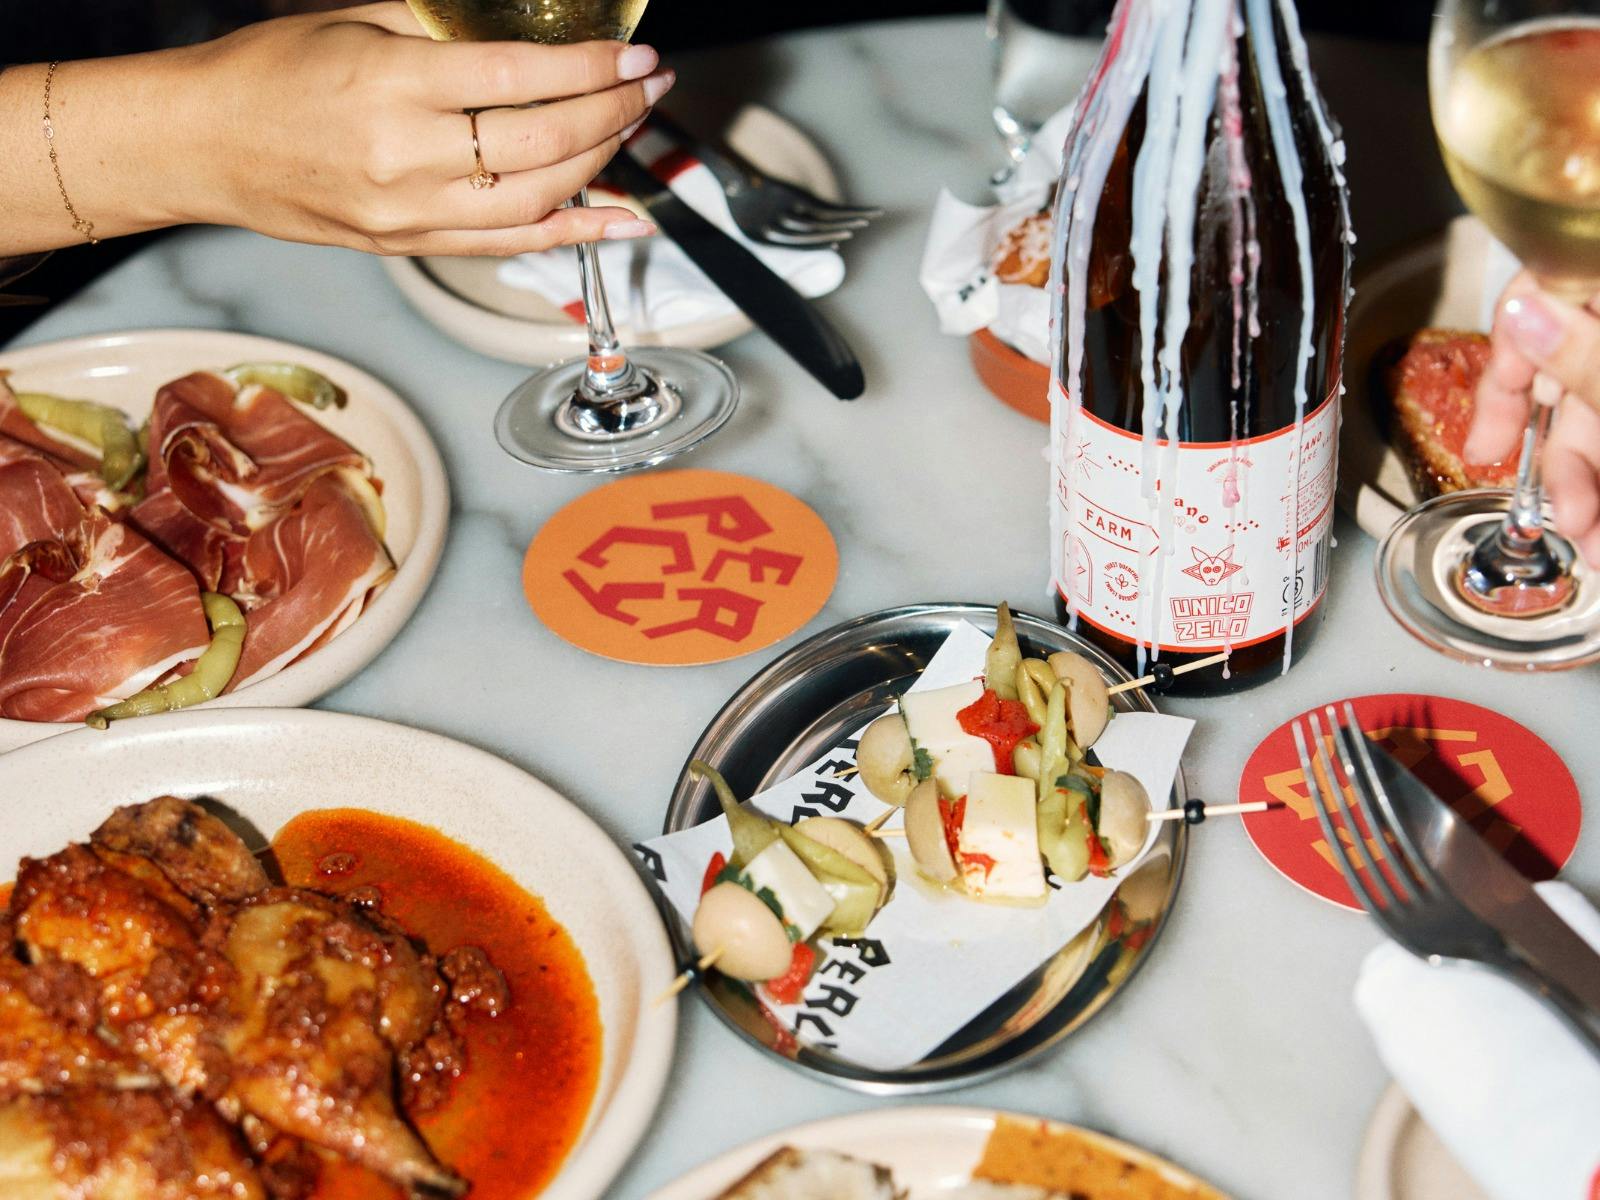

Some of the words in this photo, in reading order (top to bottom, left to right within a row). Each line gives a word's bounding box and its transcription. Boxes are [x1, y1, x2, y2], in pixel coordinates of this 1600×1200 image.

[1086, 508, 1131, 541] FARM
[1171, 593, 1253, 618] UNICO
[1175, 618, 1247, 642] ZELO
